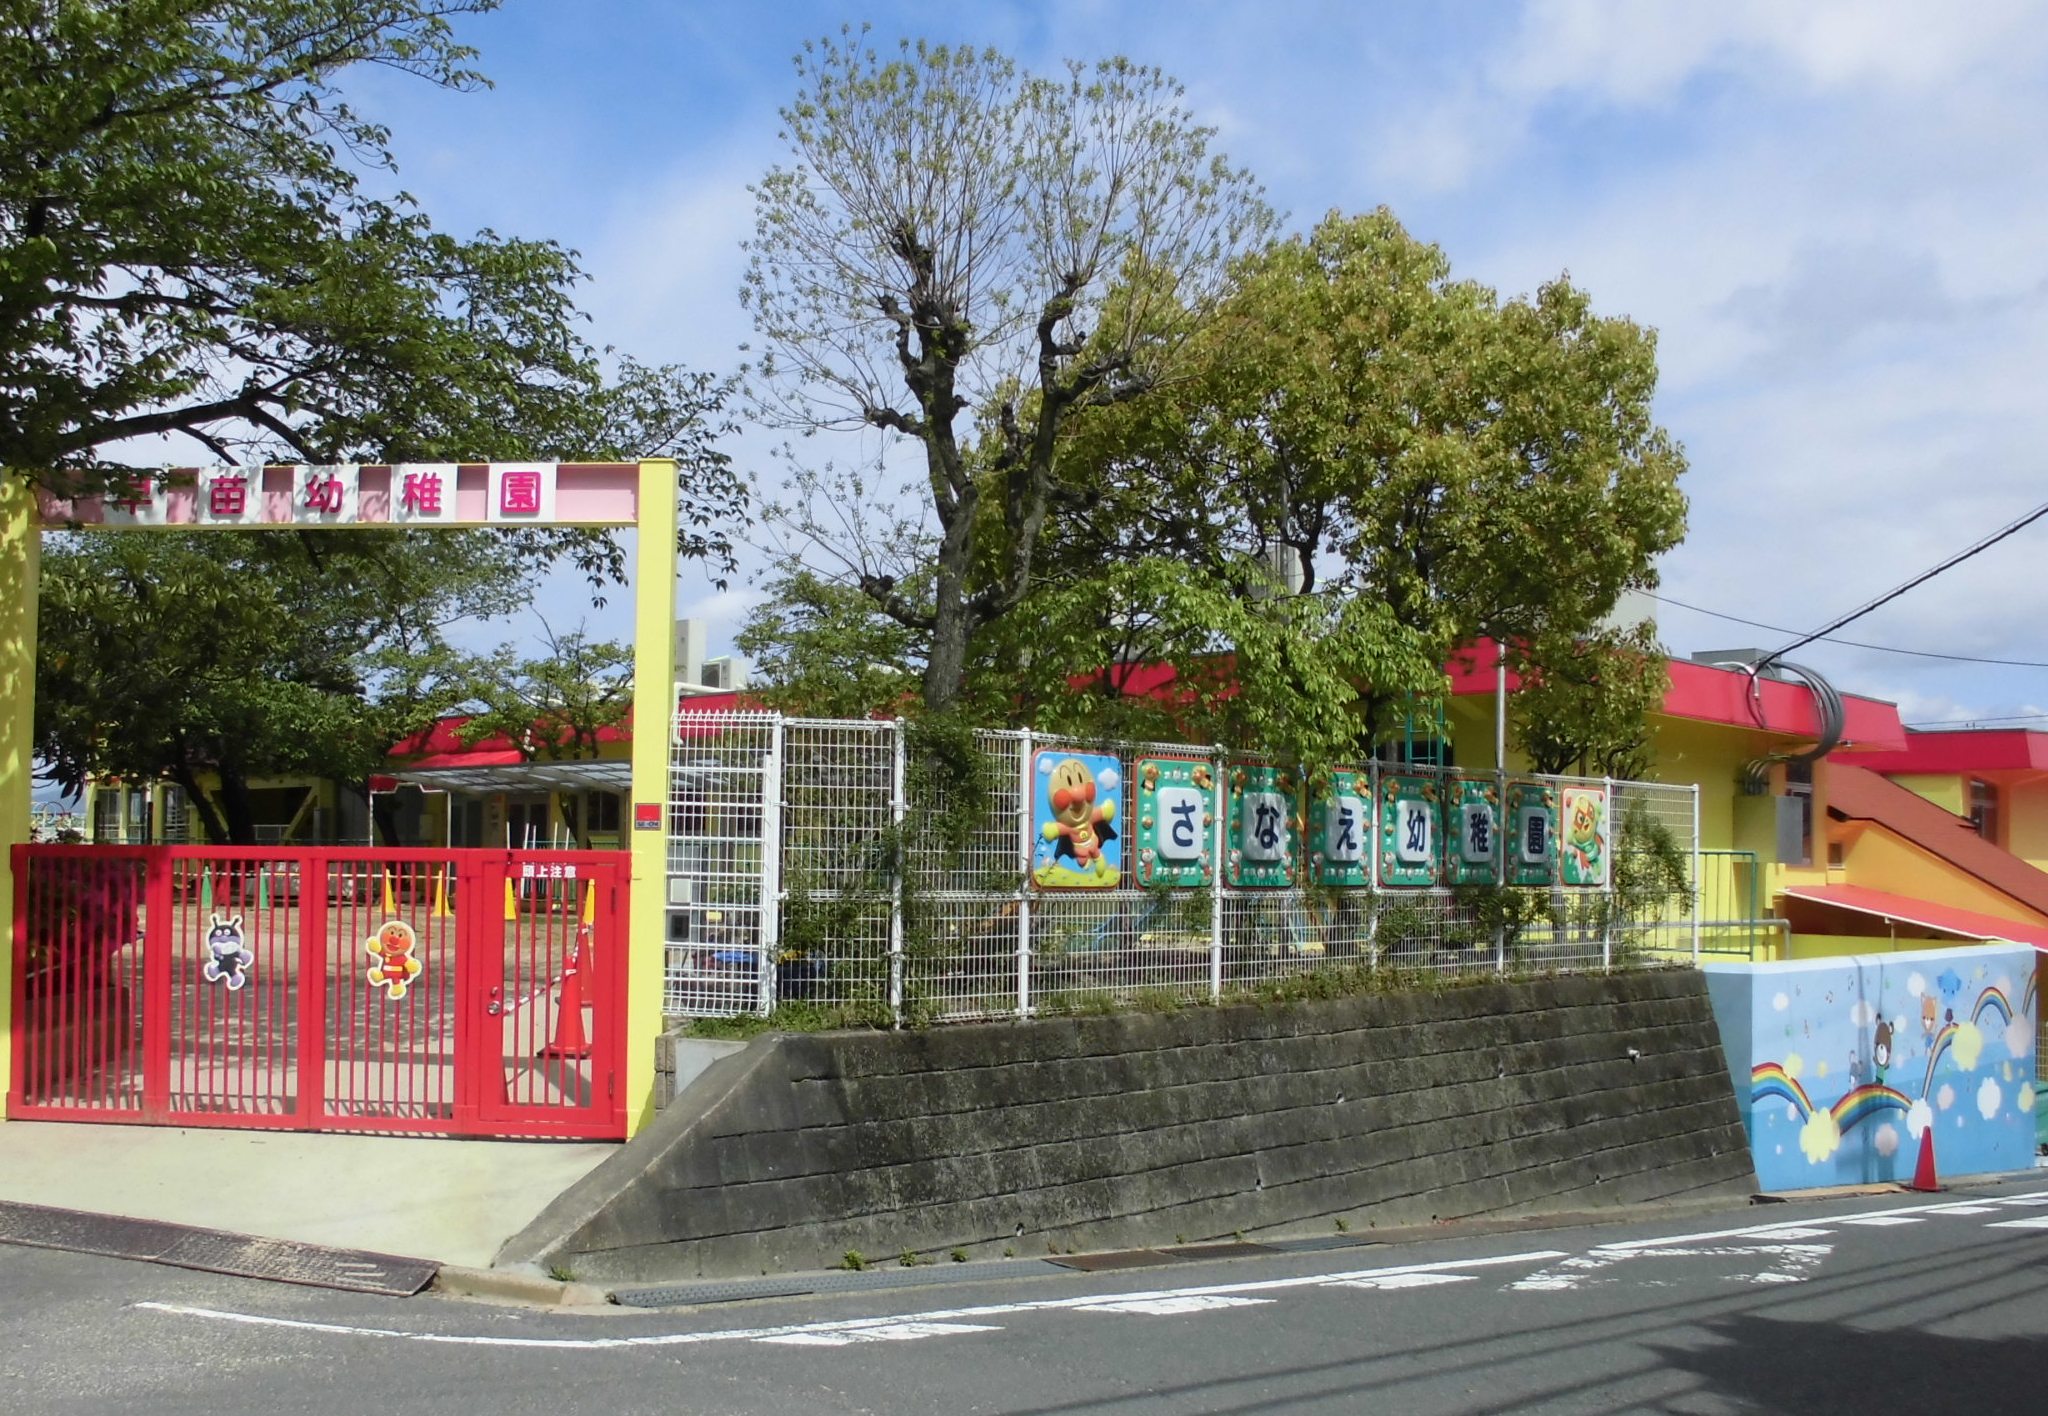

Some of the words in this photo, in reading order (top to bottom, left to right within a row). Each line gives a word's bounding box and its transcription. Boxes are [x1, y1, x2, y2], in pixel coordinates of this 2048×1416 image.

[1170, 799, 1545, 854] さなえ幼稚園
